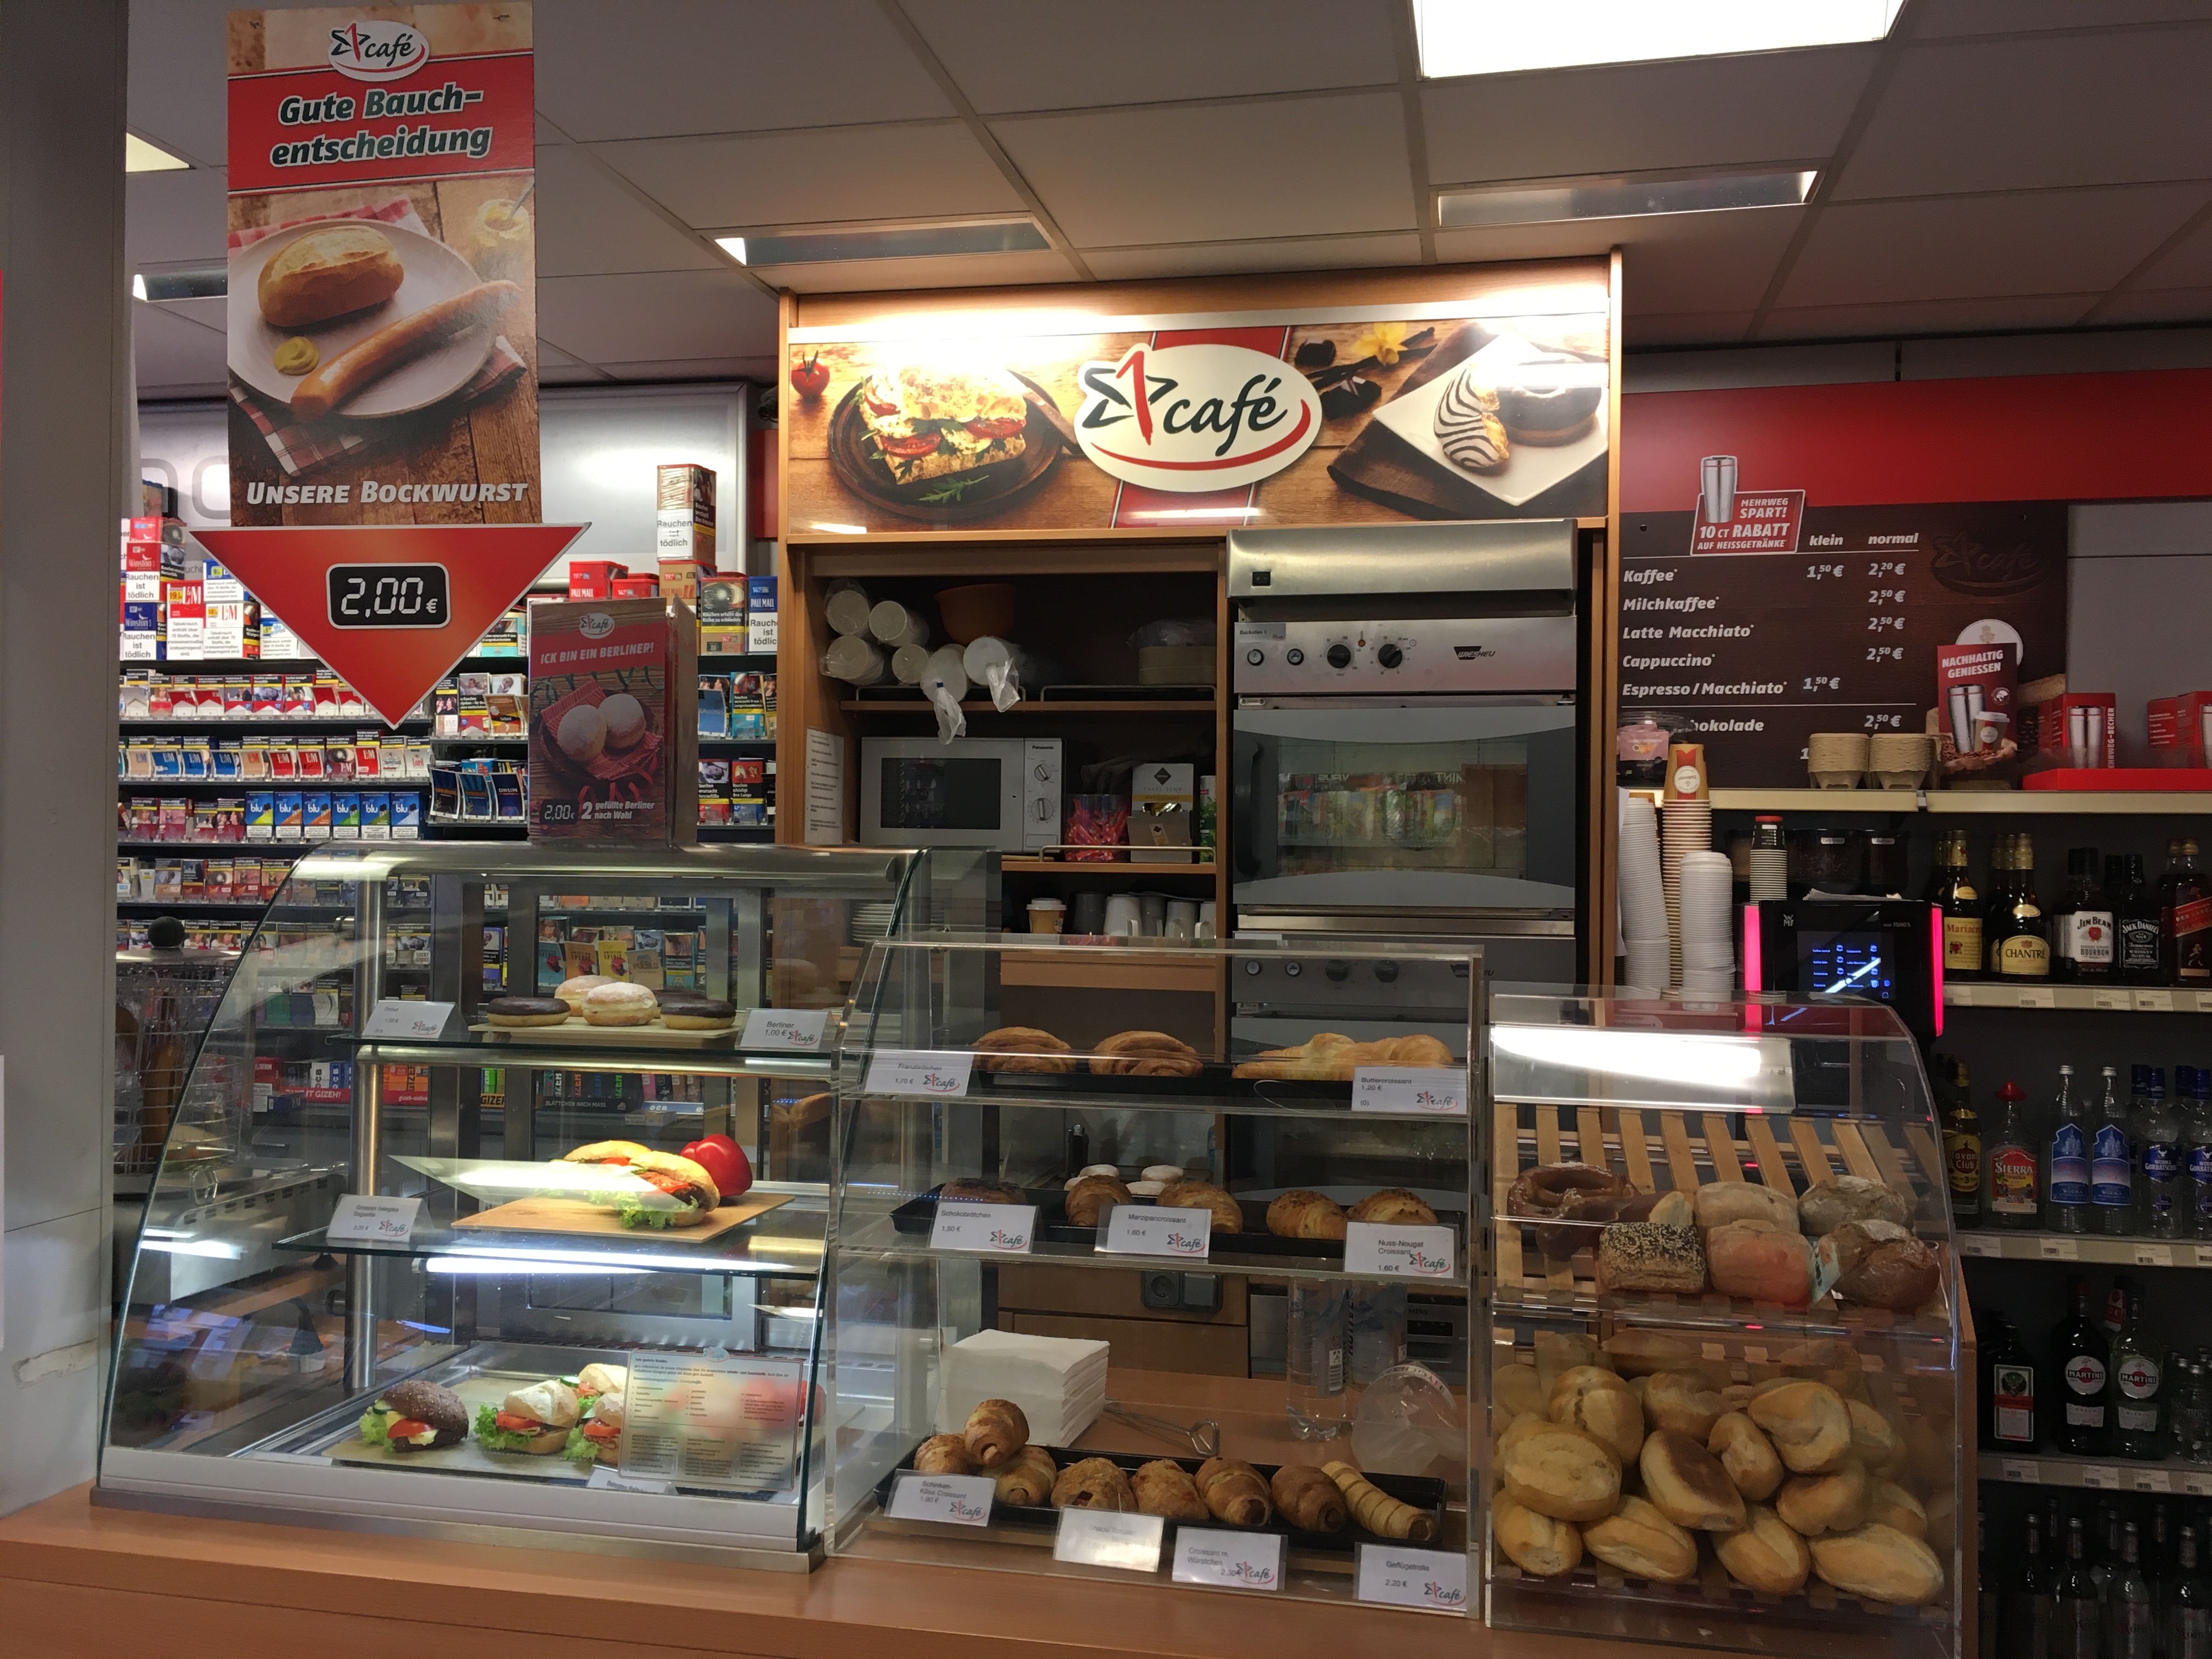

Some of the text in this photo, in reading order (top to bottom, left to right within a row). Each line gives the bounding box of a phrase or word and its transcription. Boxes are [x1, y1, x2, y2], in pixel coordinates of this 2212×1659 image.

[280, 83, 483, 125] Gute Bauch-
[270, 125, 493, 167] entscheidung
[1163, 374, 1288, 456] café
[246, 481, 528, 505] UNSERE BOCKWURST
[1741, 498, 1788, 507] MEHRWEG
[1740, 507, 1787, 519] SPART!
[657, 519, 692, 527] Rauchen
[1699, 526, 1716, 539] 10
[1732, 523, 1790, 538] RABATT
[1809, 533, 1919, 546] klein normal
[1697, 541, 1714, 550] AUF
[129, 559, 151, 567] Winston
[128, 590, 154, 599] tödlich
[751, 599, 774, 607] PALL MALL
[222, 605, 237, 620] L&M
[125, 618, 148, 627] Winston
[1623, 627, 1663, 639] Latte
[541, 642, 654, 664] ICK BIN EIN BERLINER!
[1942, 650, 2004, 668] NACHHALTIG
[1948, 662, 2001, 679] GENIESSEN
[1622, 684, 1690, 698] Espresso
[251, 803, 262, 812] blu
[279, 804, 291, 813] blu
[308, 804, 319, 813] blu
[336, 804, 348, 813] blu
[366, 804, 377, 813] blu
[396, 804, 408, 813] blu
[582, 802, 593, 820] 2
[595, 801, 624, 810] gefüllte
[625, 801, 655, 809] Berliner
[595, 811, 633, 819] nach Wahl
[2077, 919, 2091, 929] JIM
[2122, 923, 2137, 934] JACK
[1956, 1159, 1975, 1169] Club
[1995, 1163, 2033, 1174] SIERRA
[1128, 1214, 1186, 1223] Marzipancroissant
[1379, 1240, 1424, 1249] Nuss-Nougat
[1424, 1258, 1447, 1271] café
[2069, 1370, 2103, 1379] MARTINI
[2122, 1374, 2156, 1384] MARTINI
[1188, 1547, 1220, 1556] Croissant
[1187, 1556, 1223, 1566] Würstchen
